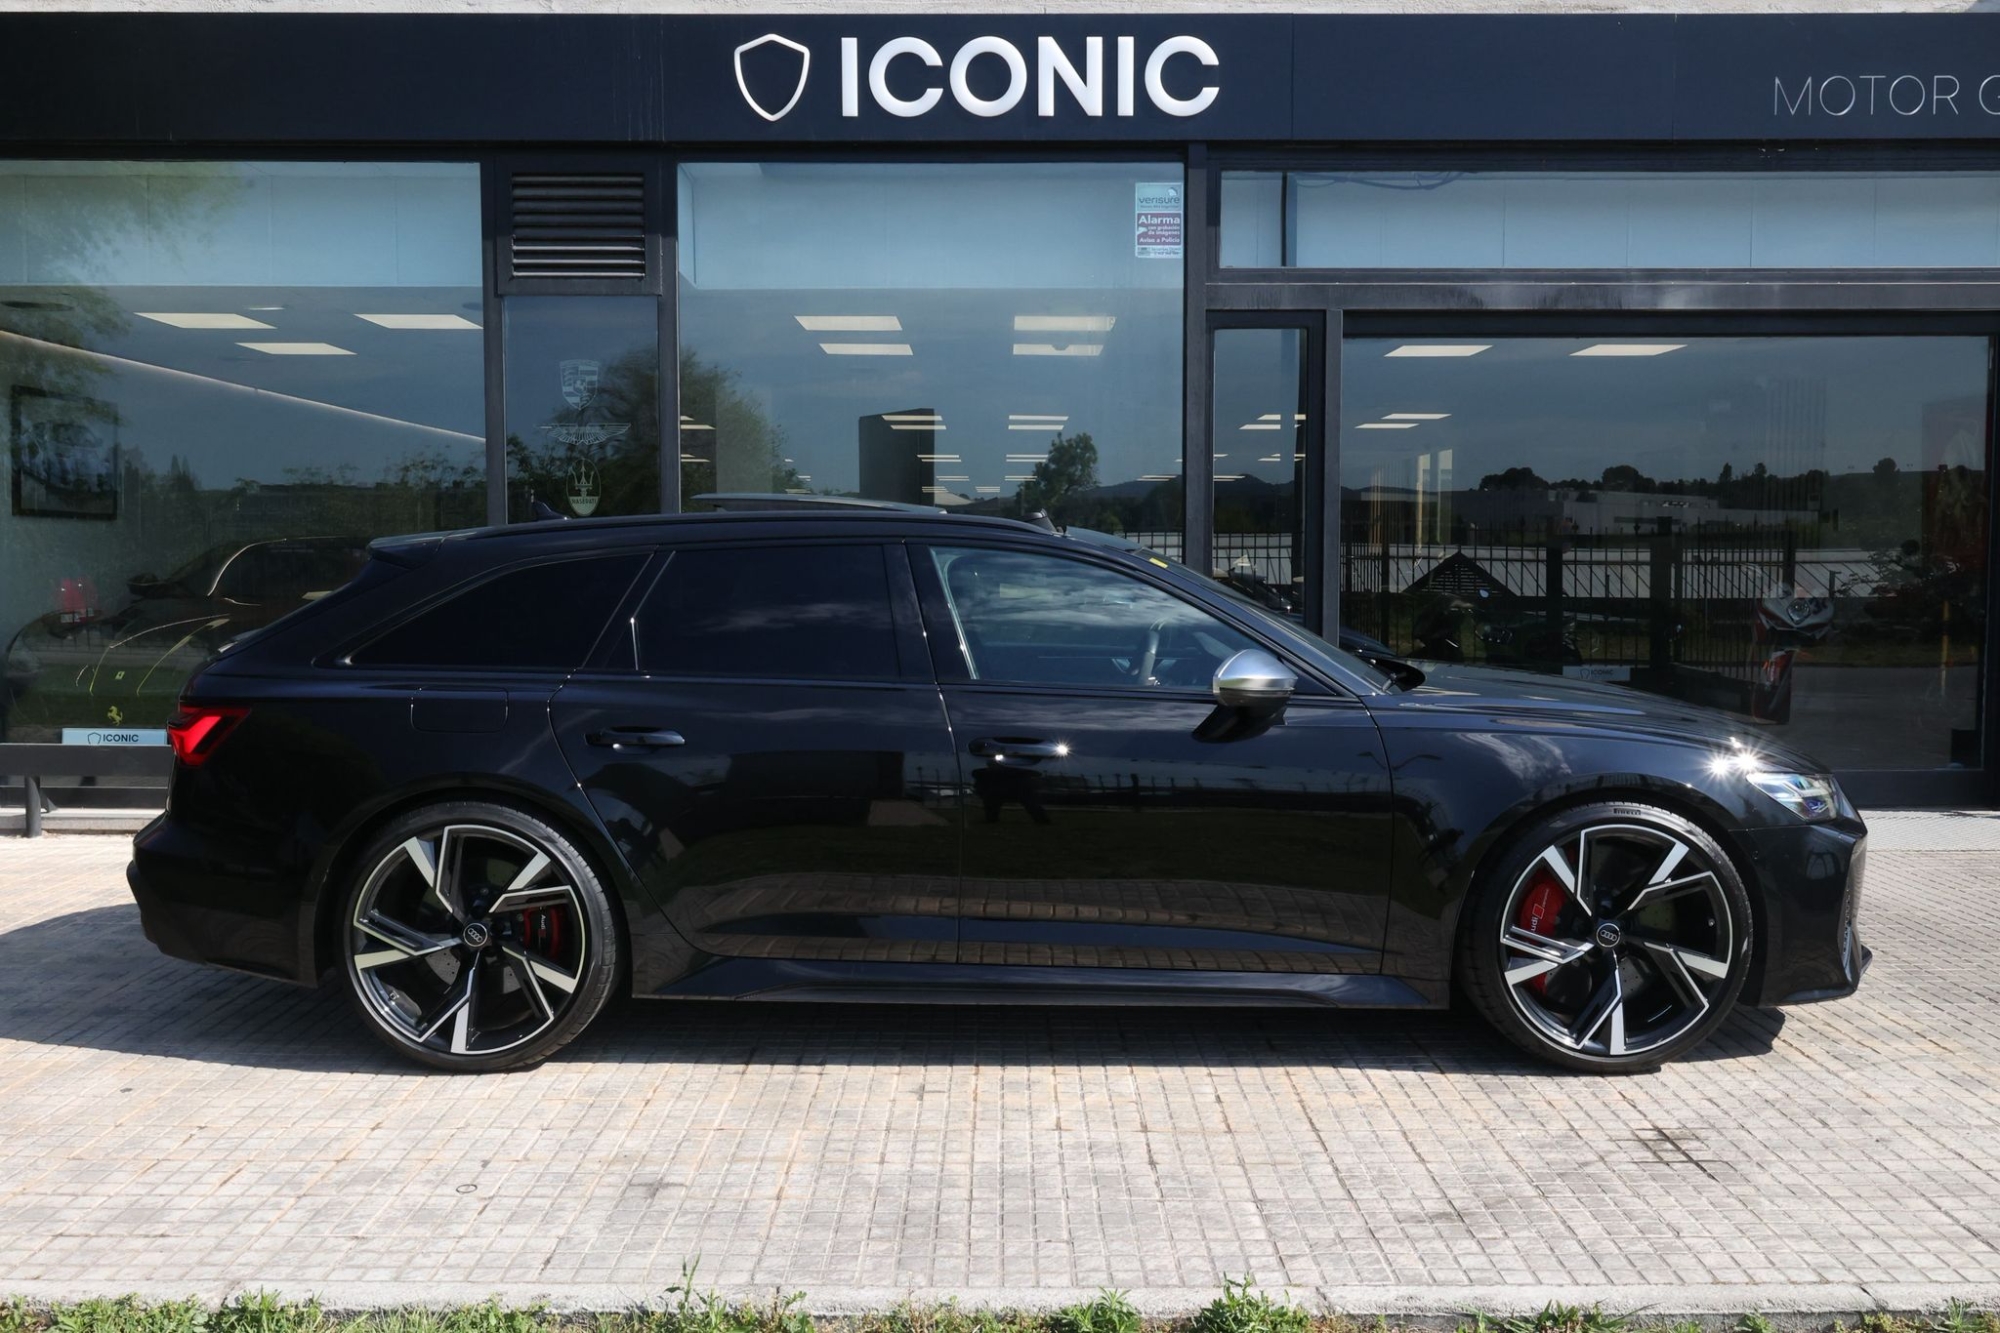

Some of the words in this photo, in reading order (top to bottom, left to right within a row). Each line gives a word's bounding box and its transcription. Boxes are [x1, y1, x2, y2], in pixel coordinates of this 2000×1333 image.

[841, 35, 1220, 118] ICONIC
[1773, 75, 1960, 116] MOTOR
[1139, 196, 1180, 204] verisure
[1138, 214, 1180, 225] Alarma
[103, 734, 139, 743] ICONIC
[1530, 917, 1539, 932] udi
